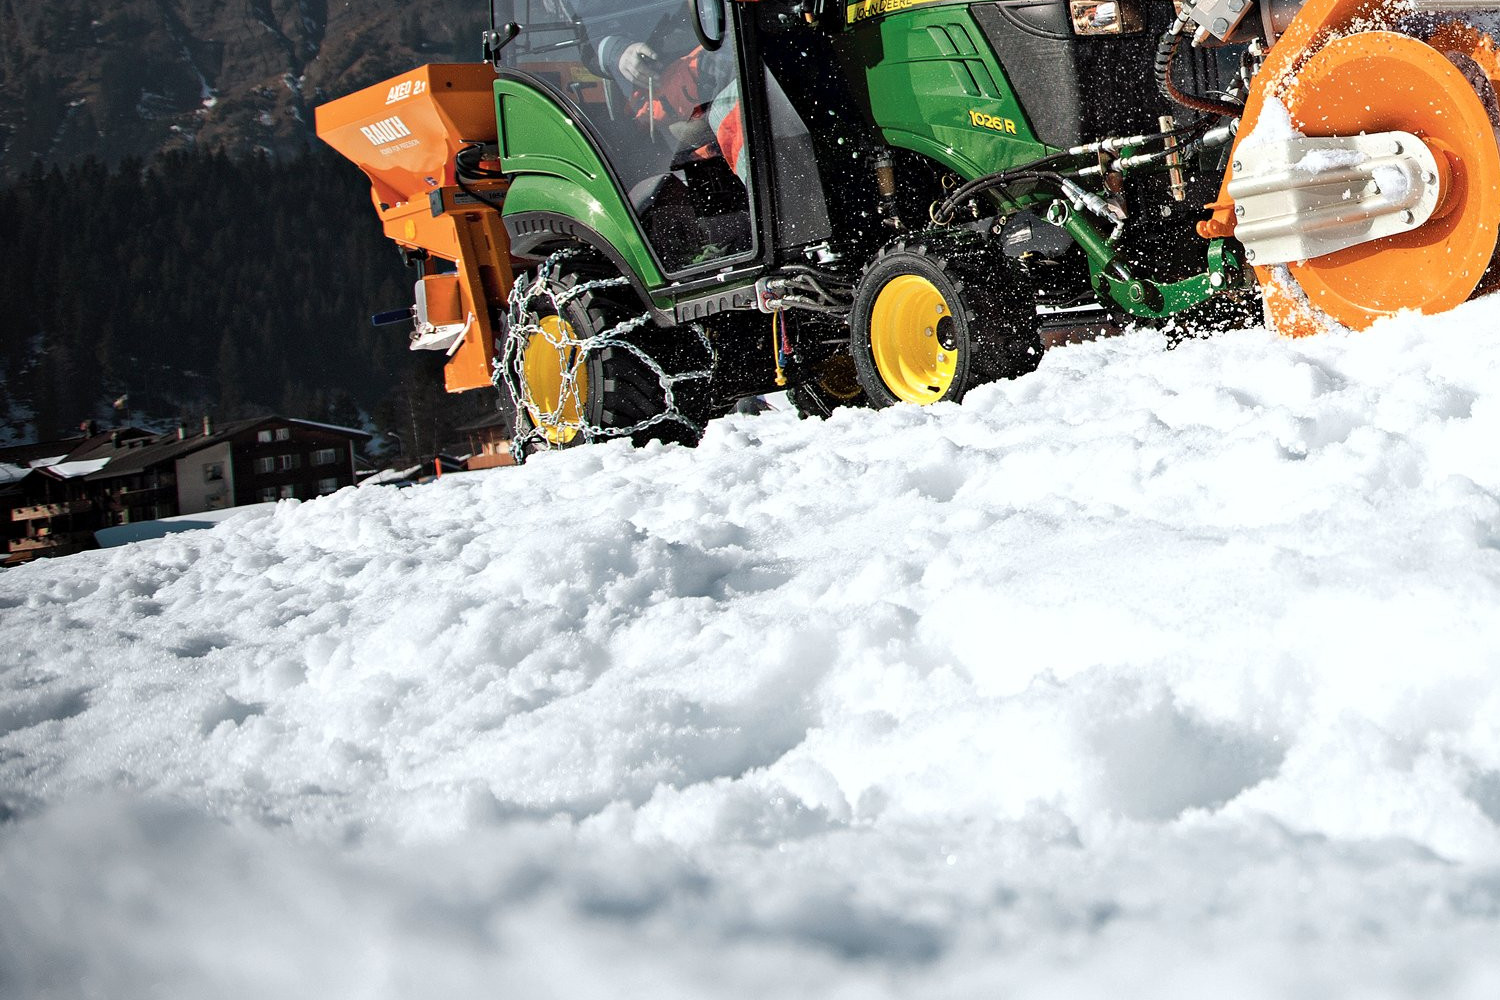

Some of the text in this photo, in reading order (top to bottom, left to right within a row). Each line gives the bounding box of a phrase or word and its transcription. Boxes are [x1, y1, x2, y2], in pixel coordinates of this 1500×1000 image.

[853, 2, 879, 22] JOHN
[386, 80, 426, 102] AXEO 2.1
[360, 115, 411, 146] RAUCH
[968, 110, 1017, 135] 1026 R
